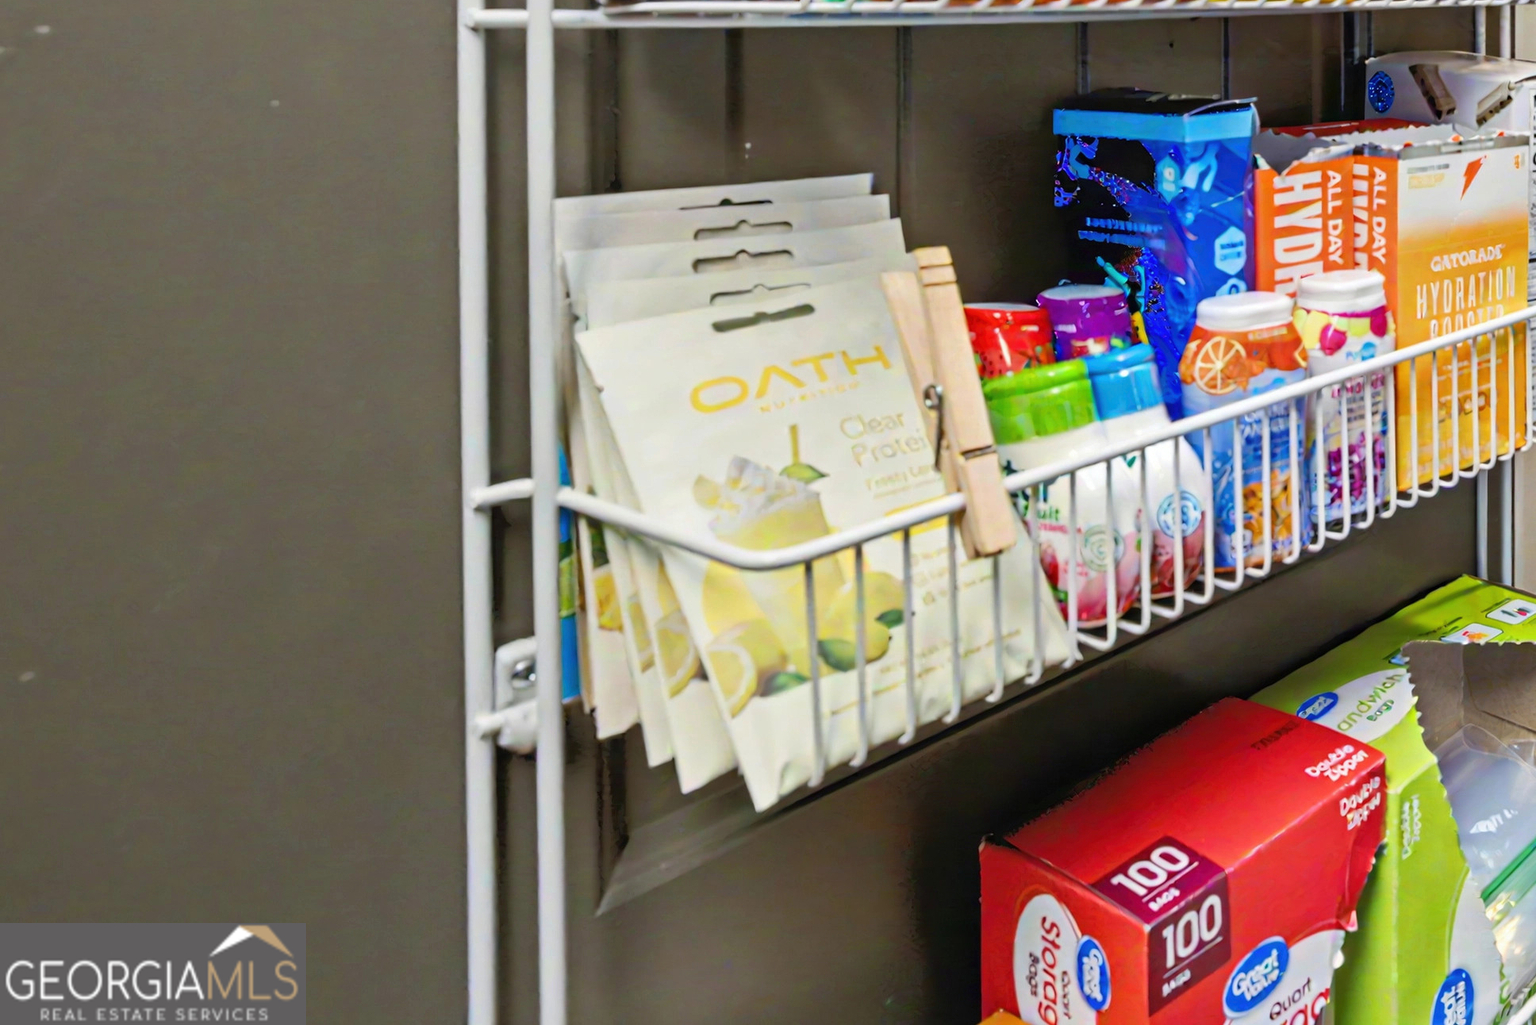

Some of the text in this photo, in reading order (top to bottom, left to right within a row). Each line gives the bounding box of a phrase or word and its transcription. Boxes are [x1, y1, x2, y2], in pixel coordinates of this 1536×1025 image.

[1326, 169, 1345, 266] ALL DAY
[1371, 166, 1388, 266] ALL DAY
[1430, 243, 1504, 273] GATORADE
[1415, 266, 1517, 320] HYDRATION
[690, 344, 893, 414] OATH
[839, 411, 906, 441] Clear
[851, 428, 928, 468] Protei
[1336, 672, 1404, 733] andwich
[1110, 845, 1191, 898] 100
[1161, 893, 1224, 970] 100
[1231, 947, 1280, 997] Great
[1269, 976, 1314, 1022] Quart
